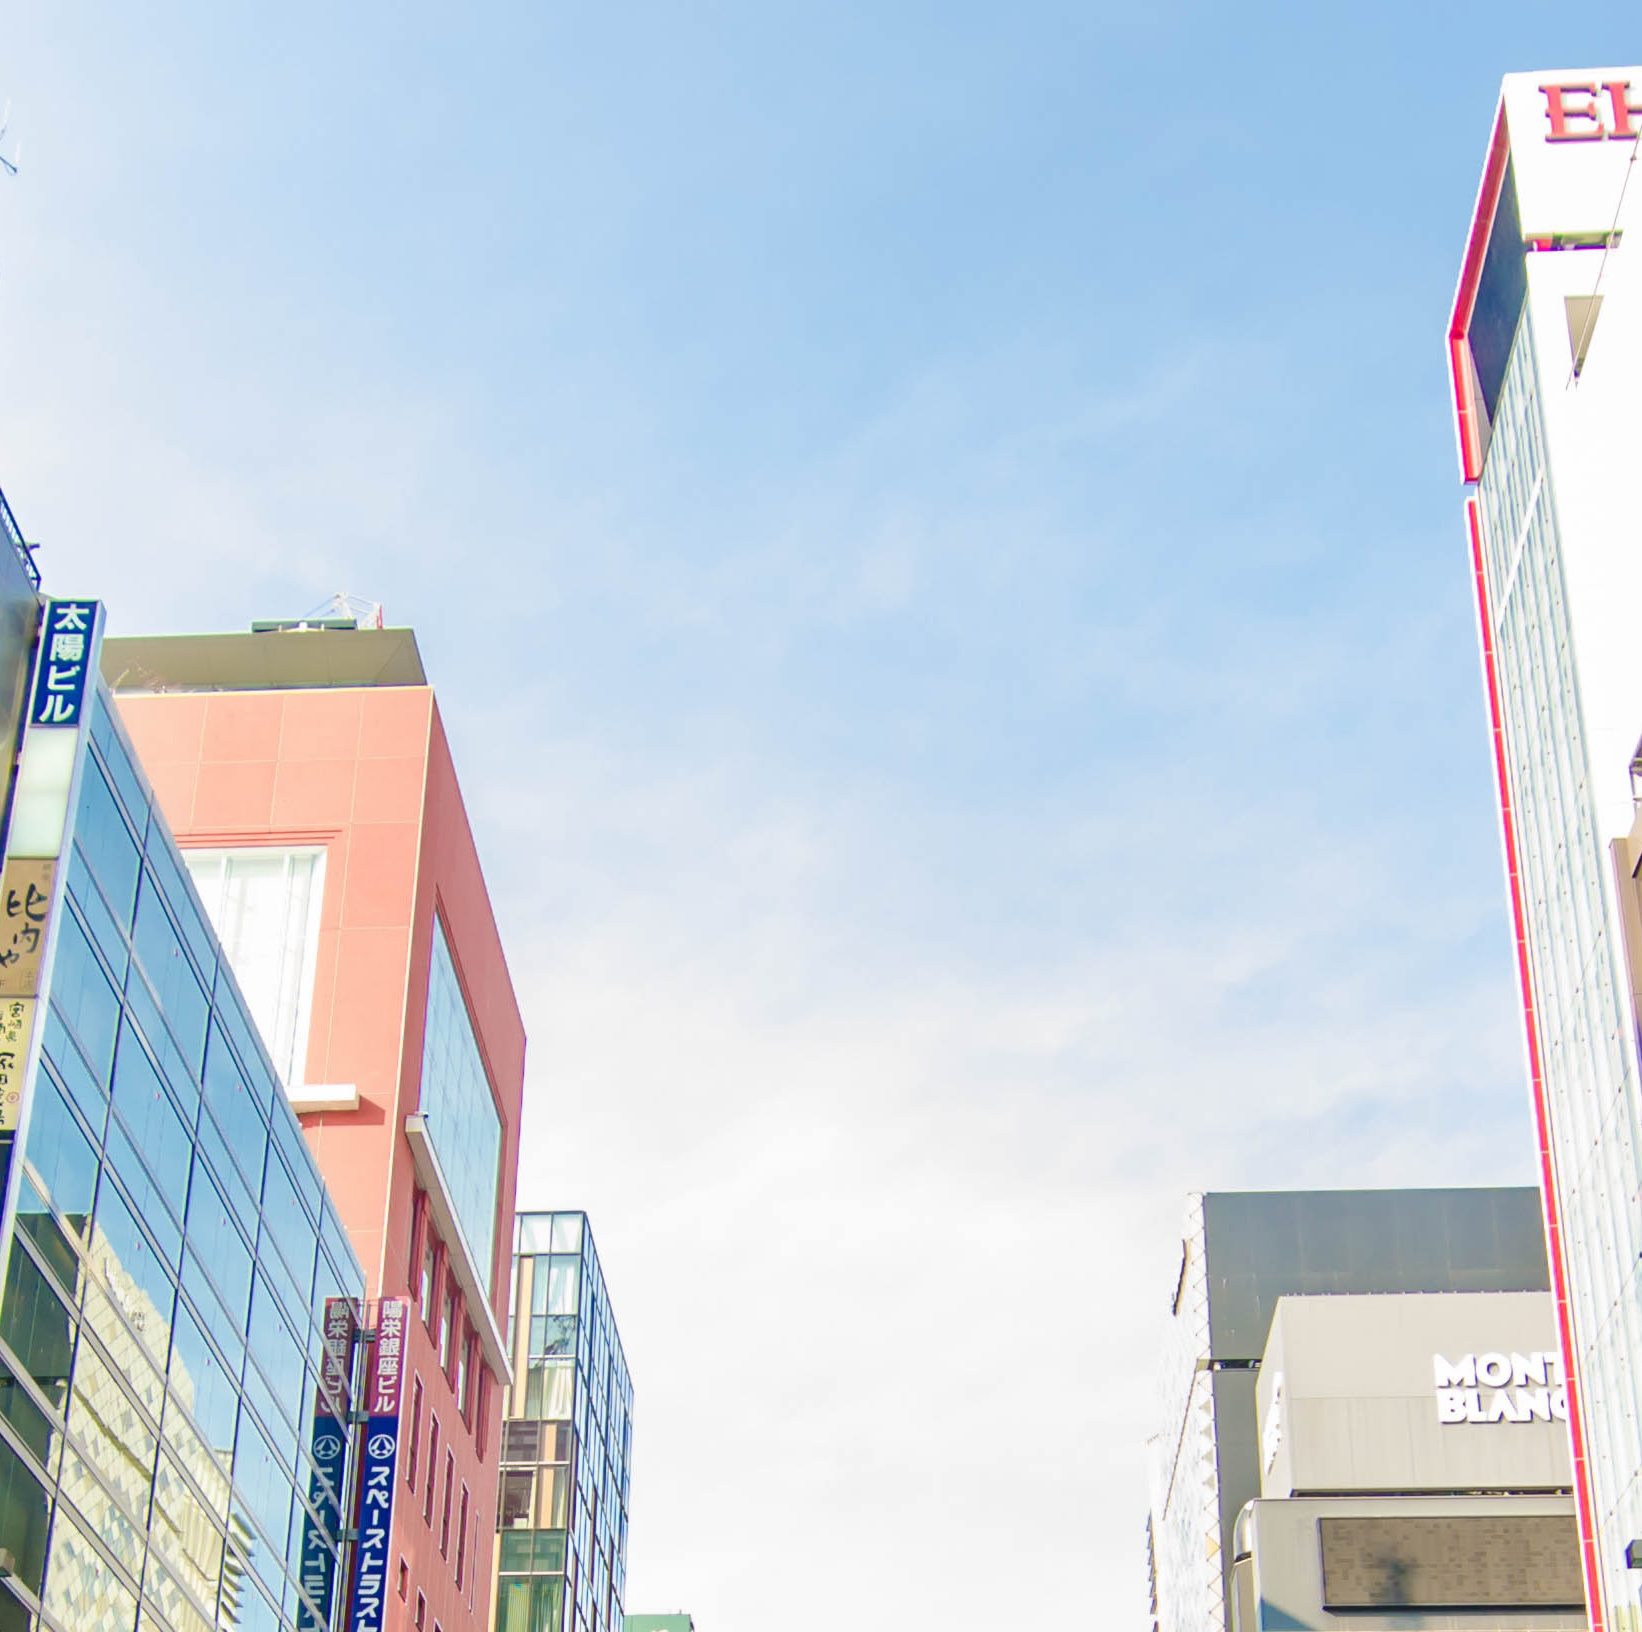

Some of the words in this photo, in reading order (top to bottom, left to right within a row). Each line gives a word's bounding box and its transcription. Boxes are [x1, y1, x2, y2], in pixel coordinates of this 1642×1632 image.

[39, 603, 90, 723] 太陽ビル
[374, 1301, 402, 1412] 陽栄銀座ビル
